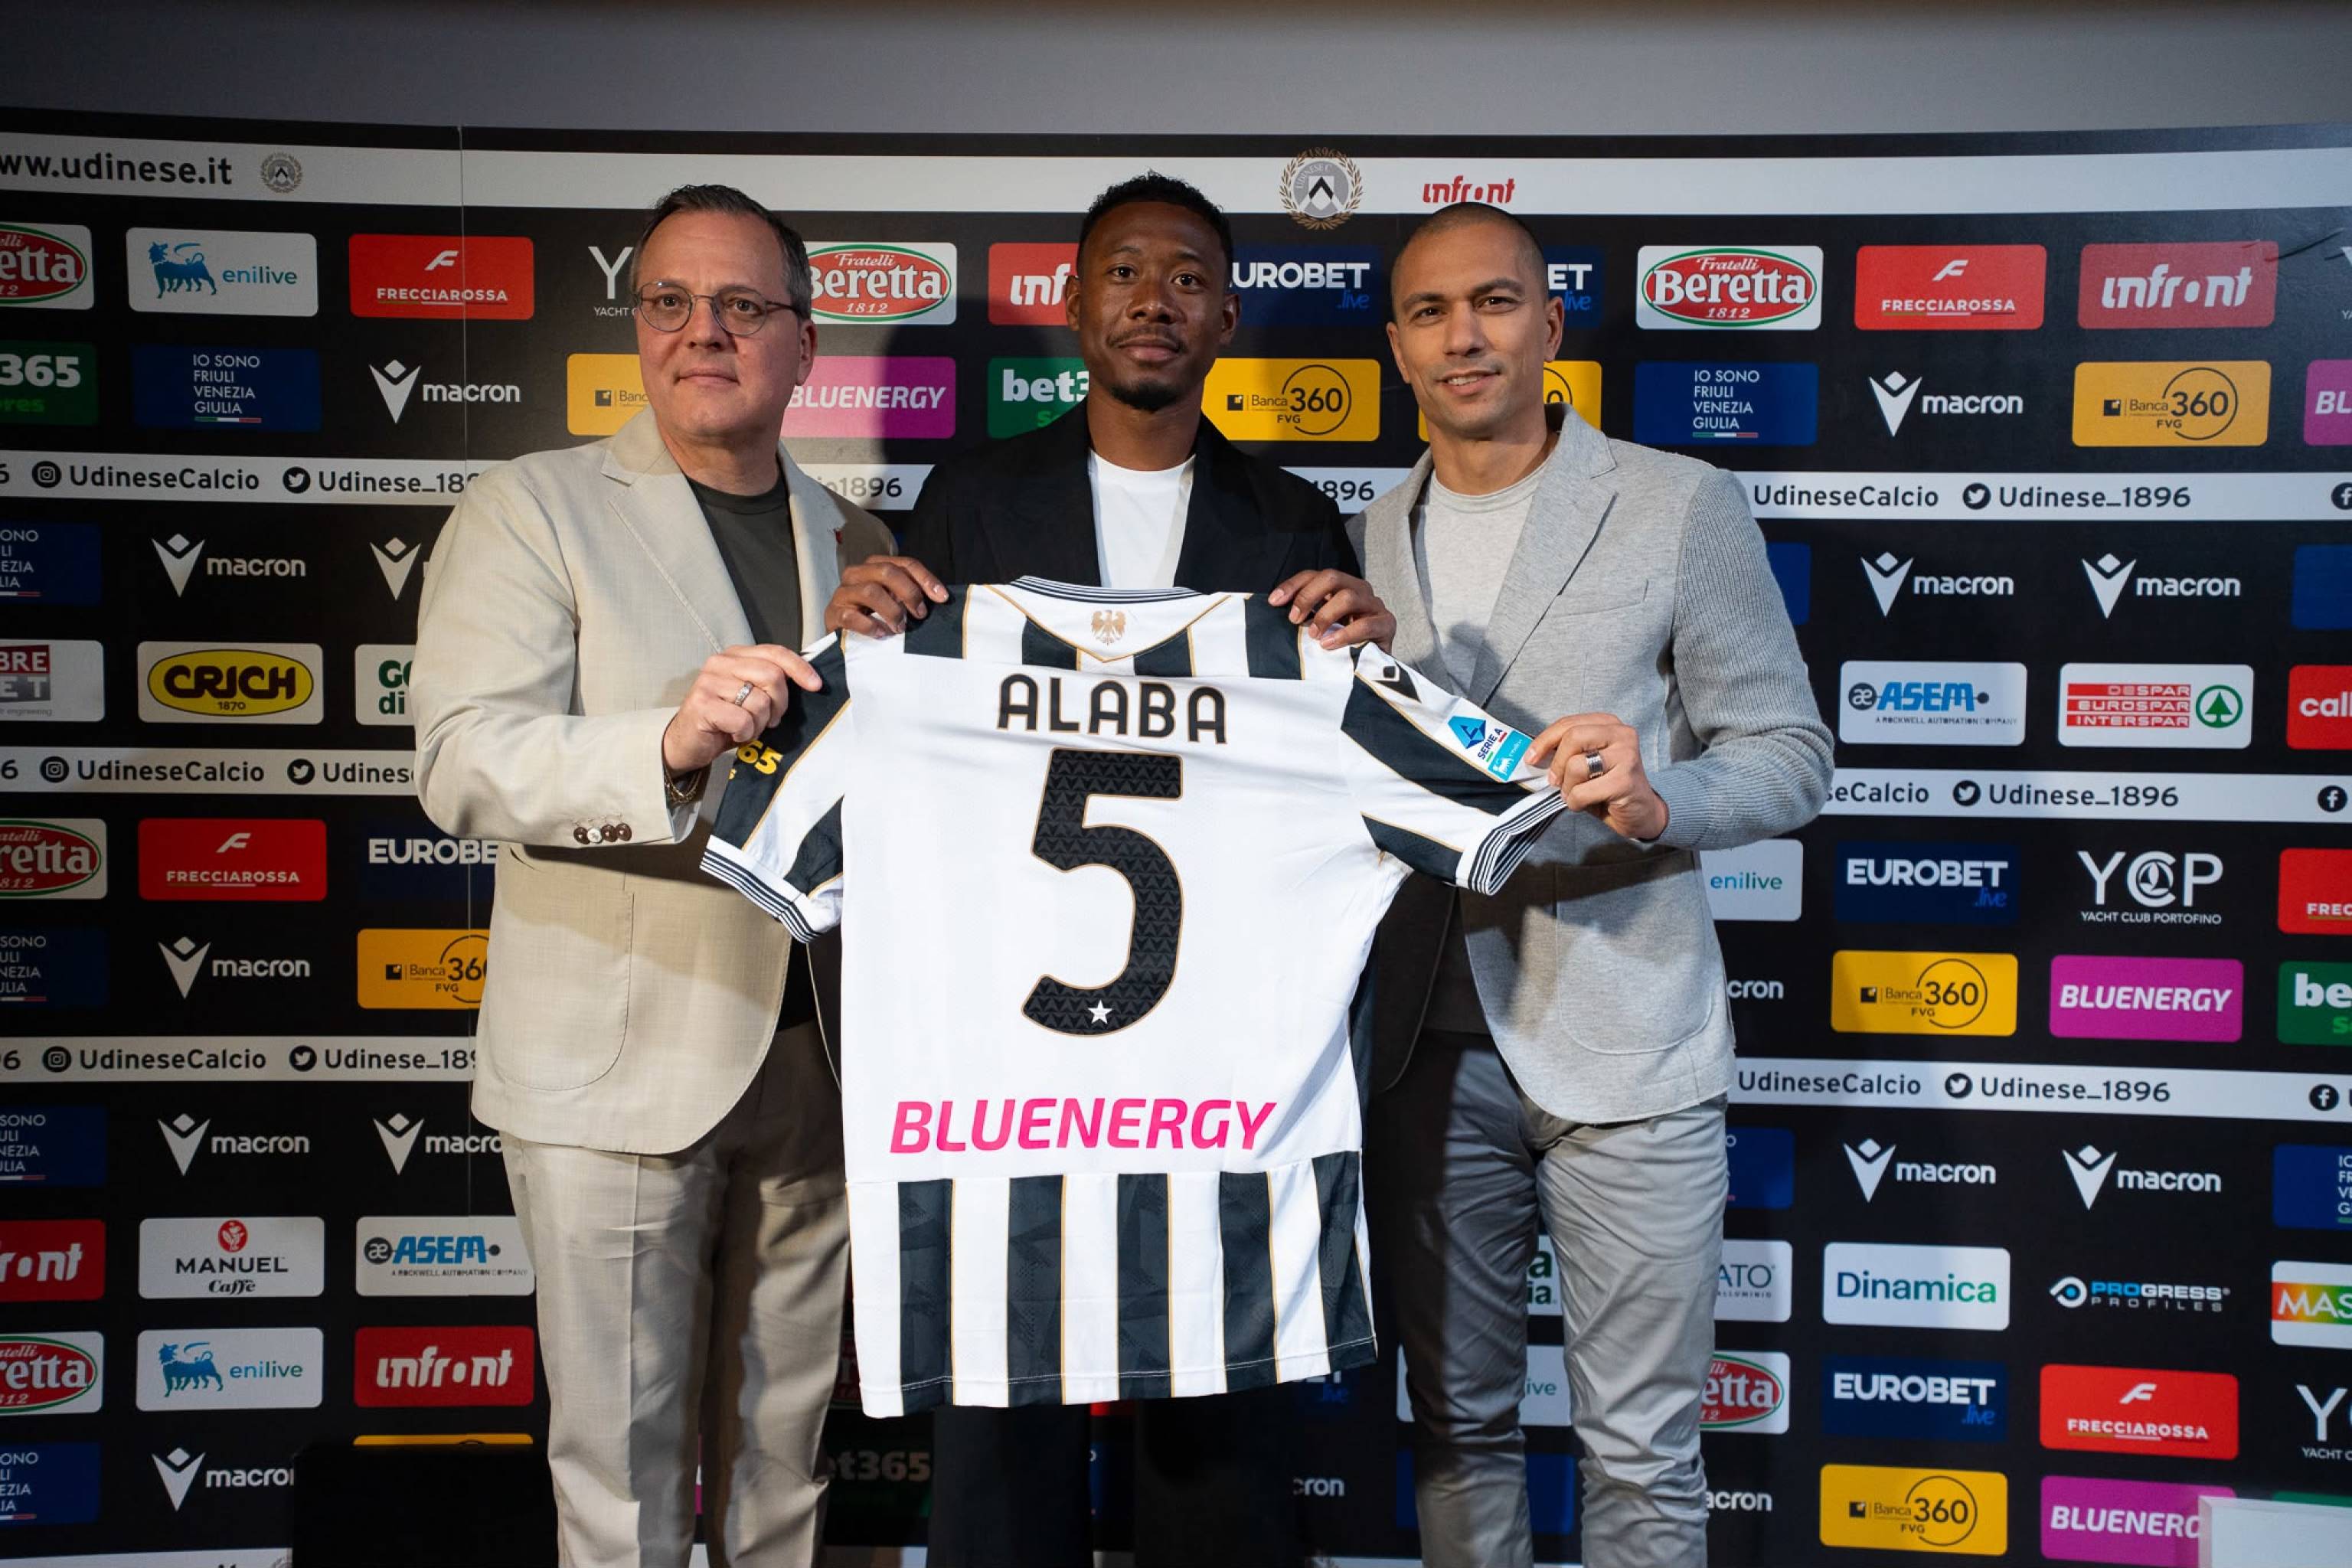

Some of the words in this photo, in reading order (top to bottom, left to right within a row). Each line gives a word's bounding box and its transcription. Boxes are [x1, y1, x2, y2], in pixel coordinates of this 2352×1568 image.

[1423, 175, 1515, 203] infront
[834, 253, 896, 267] Fratelli
[1696, 256, 1759, 272] Fratelli
[222, 265, 298, 285] enilive
[810, 263, 943, 300] Beretta
[1011, 263, 1078, 305] inf
[1230, 263, 1370, 289] UROBET
[377, 287, 508, 302] FRECCIAROSSA
[1653, 270, 1808, 305] Beretta
[2101, 263, 2252, 309] infront
[594, 307, 627, 317] YACHT
[844, 302, 888, 313] 1812
[1706, 307, 1750, 318] 1812
[1881, 299, 2016, 312] FRECCIAROSSA
[192, 354, 209, 367] IO
[214, 354, 260, 368] SONO
[193, 370, 234, 383] FRIULI
[1694, 370, 1710, 382] IO
[1715, 369, 1759, 383] SONO
[194, 385, 255, 399] VENEZIA
[423, 384, 520, 403] macron
[789, 385, 946, 409] BLUENERGY
[1251, 394, 1288, 407] Banca
[1289, 387, 1343, 413] 360
[1694, 385, 1733, 398] FRIULI
[194, 400, 243, 414] GIULIA
[1693, 401, 1753, 414] VENEZIA
[1922, 394, 2023, 414] macron
[2130, 399, 2168, 412] Banca
[2171, 391, 2229, 416] 360
[1277, 414, 1301, 423] FVG
[1693, 416, 1740, 430] GIULIA
[2157, 419, 2182, 429] FVG
[69, 466, 260, 491] UdineseCalcio
[1754, 485, 1939, 507] UdineseCalcio
[2000, 487, 2191, 508] Udinese_1896
[207, 557, 305, 577] macron
[1914, 576, 2014, 595] macron
[2136, 577, 2240, 597] macron
[163, 665, 296, 699] CRICH
[2107, 685, 2190, 696] DESPAR
[217, 701, 246, 711] 1870
[1877, 681, 1975, 712] ASEM
[2077, 700, 2190, 711] EUROSPAR
[998, 673, 1227, 746] ALABA
[2076, 715, 2189, 727] INTERSPAR
[1478, 733, 1498, 760] SERIE
[78, 760, 264, 782] UdineseCalcio
[1990, 785, 2179, 807] Udinese_1896
[166, 870, 300, 884] FRECCIAROSSA
[1710, 871, 1782, 890] enilive
[1847, 858, 2008, 887] EUROBET
[2077, 851, 2223, 908] YCP
[1020, 747, 1183, 1038] 5
[2081, 911, 2119, 923] YACHT
[2122, 912, 2151, 923] CLUB
[2154, 913, 2222, 925] PORTOFINO
[212, 959, 310, 978] macron
[410, 964, 446, 977] Banca
[435, 983, 459, 993] FVG
[1885, 988, 1922, 1000] Banca
[1925, 982, 1978, 1005] 360
[2060, 985, 2232, 1012] BLUENERGY
[1911, 1008, 1935, 1017] FVG
[80, 1049, 266, 1070] UdineseCalcio
[1738, 1072, 1921, 1095] UdineseCalcio
[1981, 1078, 2171, 1102] Udinese_1896
[889, 1096, 1279, 1155] BLUENERGY
[211, 1135, 309, 1154] macron
[1896, 1163, 1996, 1184] macron
[2118, 1169, 2221, 1192] macron
[392, 1235, 487, 1264] ASEM
[175, 1256, 287, 1274] MANUEL
[1838, 1270, 1996, 1305] Dinamica
[2091, 1298, 2223, 1312] PROFILES
[229, 1360, 303, 1380] enilive
[377, 1345, 513, 1388] infront
[1834, 1373, 1996, 1406] EUROBET
[2067, 1419, 2209, 1439] FRECCIAROSSA
[2301, 1447, 2343, 1460] YACHT
[1873, 1502, 1912, 1516] Banca
[1914, 1498, 1968, 1524] 360
[1900, 1524, 1925, 1534] FVG
